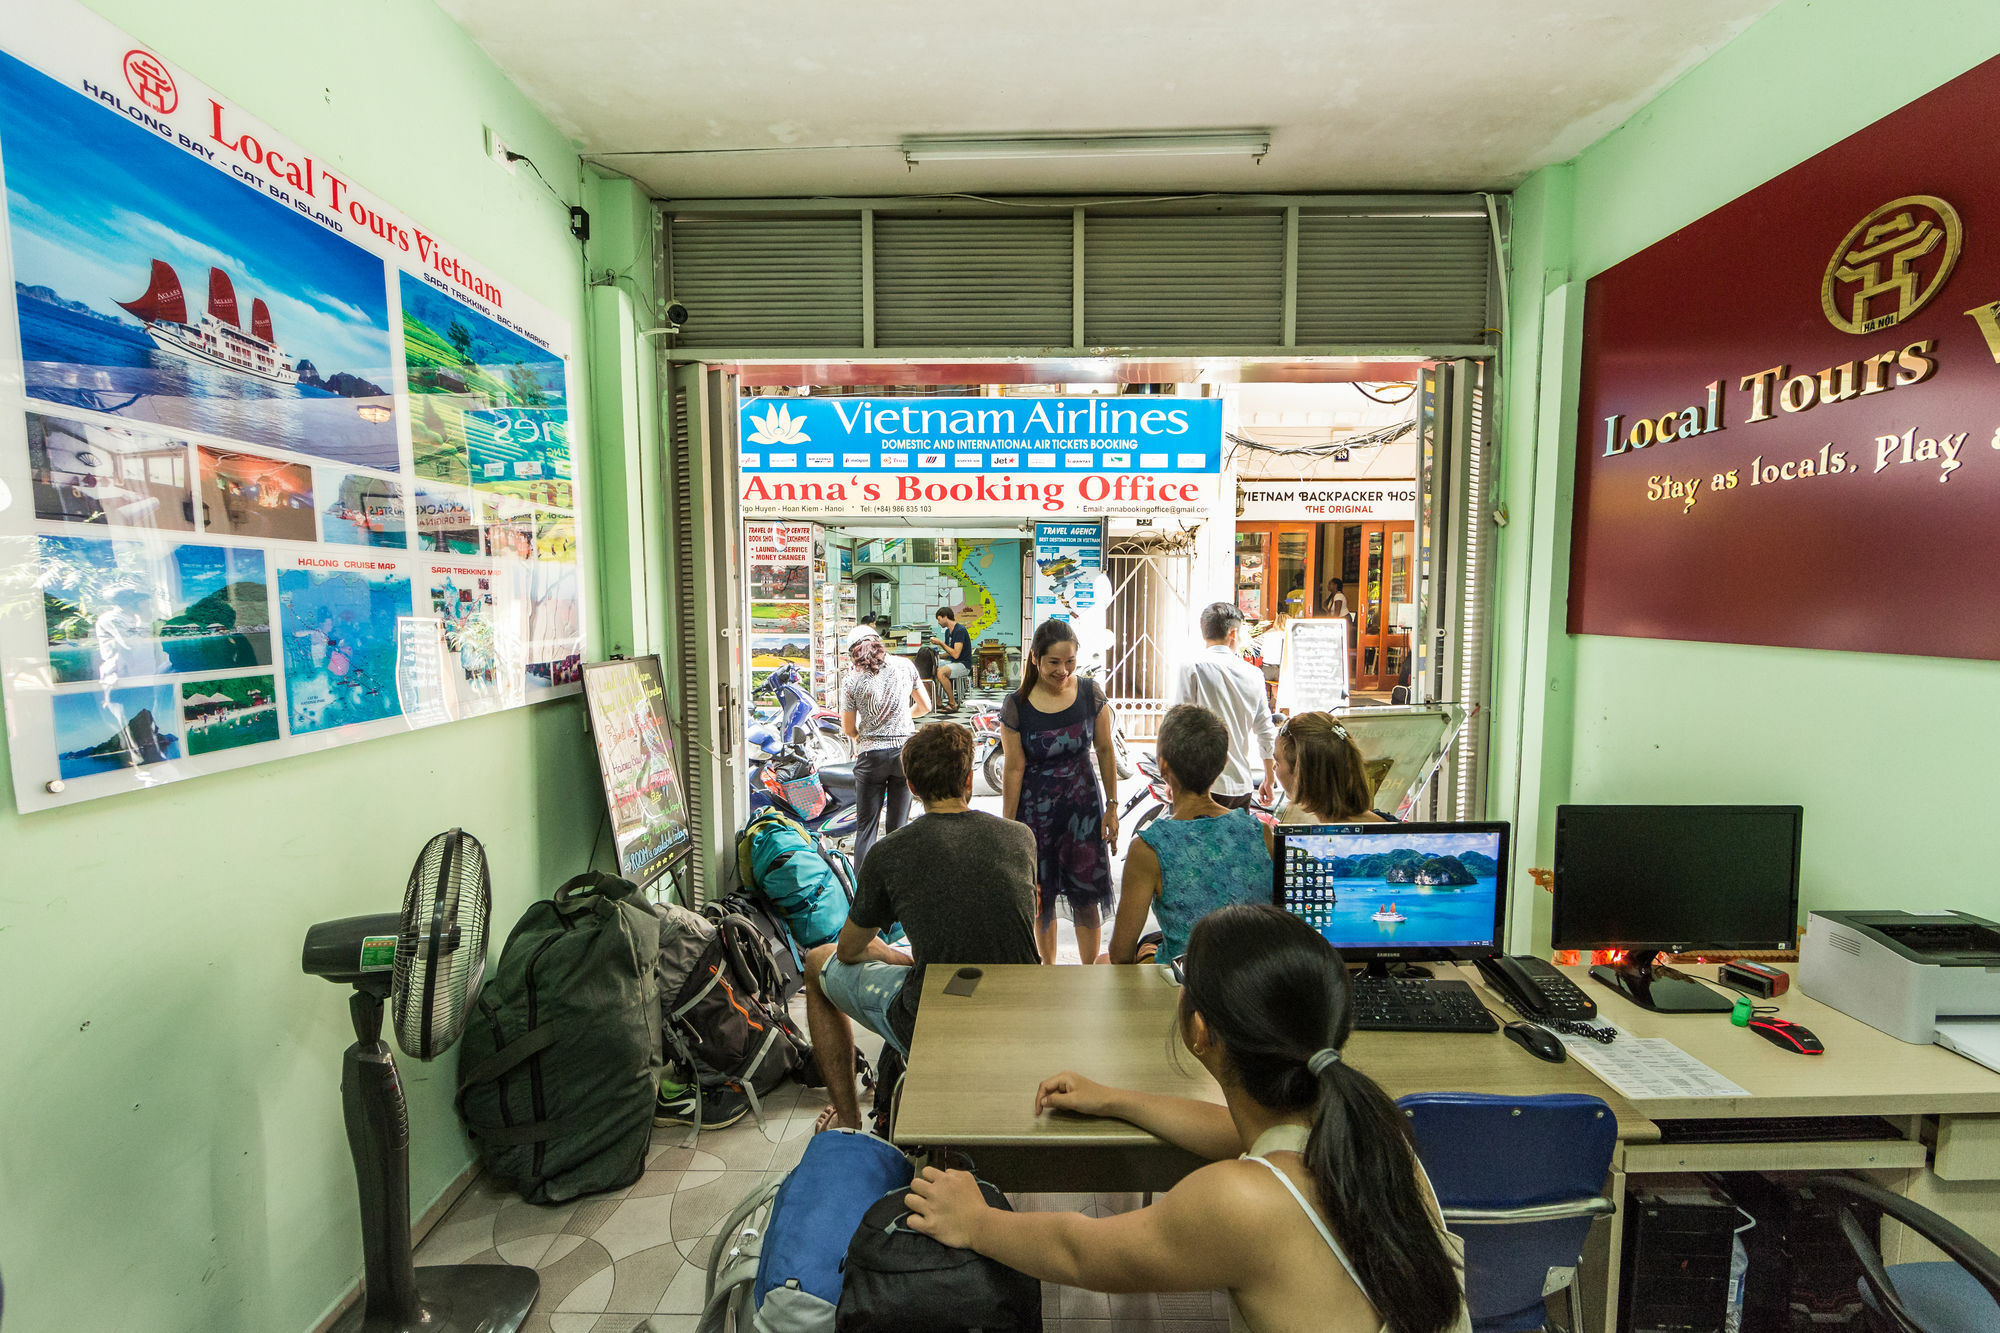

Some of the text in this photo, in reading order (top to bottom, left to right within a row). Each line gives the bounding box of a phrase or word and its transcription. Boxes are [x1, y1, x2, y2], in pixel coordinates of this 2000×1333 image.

[83, 79, 172, 137] HALONG
[178, 132, 214, 160] BAY
[232, 164, 264, 188] CAT
[269, 184, 290, 204] BA
[294, 198, 343, 232] ISLAND
[208, 98, 502, 308] Local Tours Vietnam
[424, 272, 448, 292] SAPA
[450, 288, 490, 316] TREKKING
[497, 314, 512, 328] BAC
[524, 330, 550, 349] MARKET
[1602, 380, 1723, 457] Local
[1739, 340, 1933, 424] Tours
[832, 400, 1189, 435] Vietnam Airlines
[882, 439, 1138, 450] DOMESTIC AND INTERNATIONAL AIR TICKETS BOOKING
[1647, 474, 1700, 514] Stay
[1711, 469, 1739, 491] as
[1874, 426, 1970, 483] Play
[755, 505, 776, 514] Huyen
[874, 505, 891, 514] (+84)
[895, 474, 1064, 512] Booking
[1078, 475, 1200, 502] Office
[1298, 491, 1383, 502] BACKPACKER
[298, 558, 339, 568] HALONG
[344, 560, 376, 569] CRUISE
